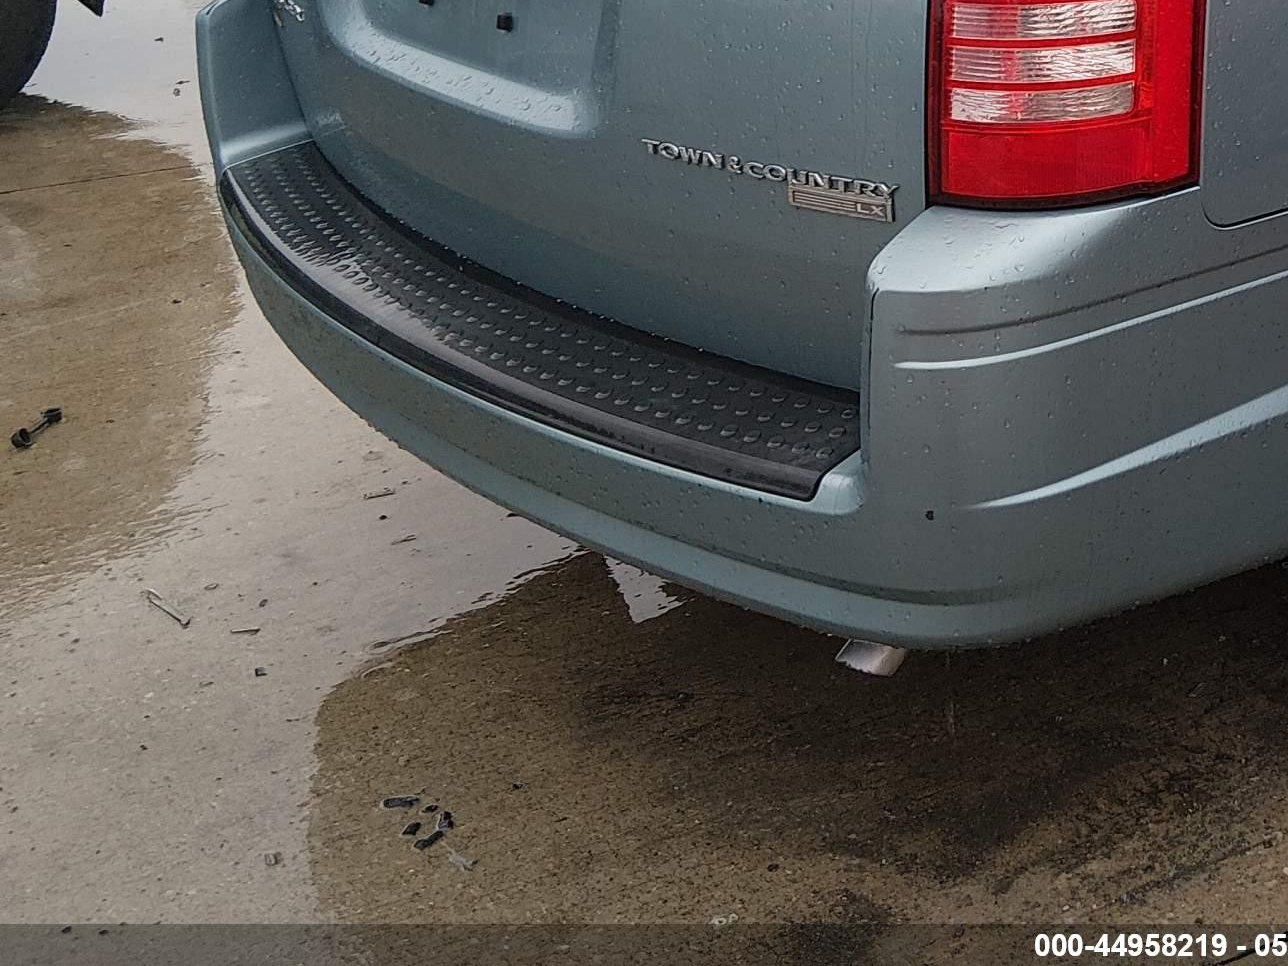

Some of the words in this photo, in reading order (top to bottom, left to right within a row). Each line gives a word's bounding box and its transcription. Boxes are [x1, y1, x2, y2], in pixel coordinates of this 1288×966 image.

[641, 138, 724, 170] TOWN
[743, 161, 899, 199] COUNTRY
[855, 202, 886, 217] LX
